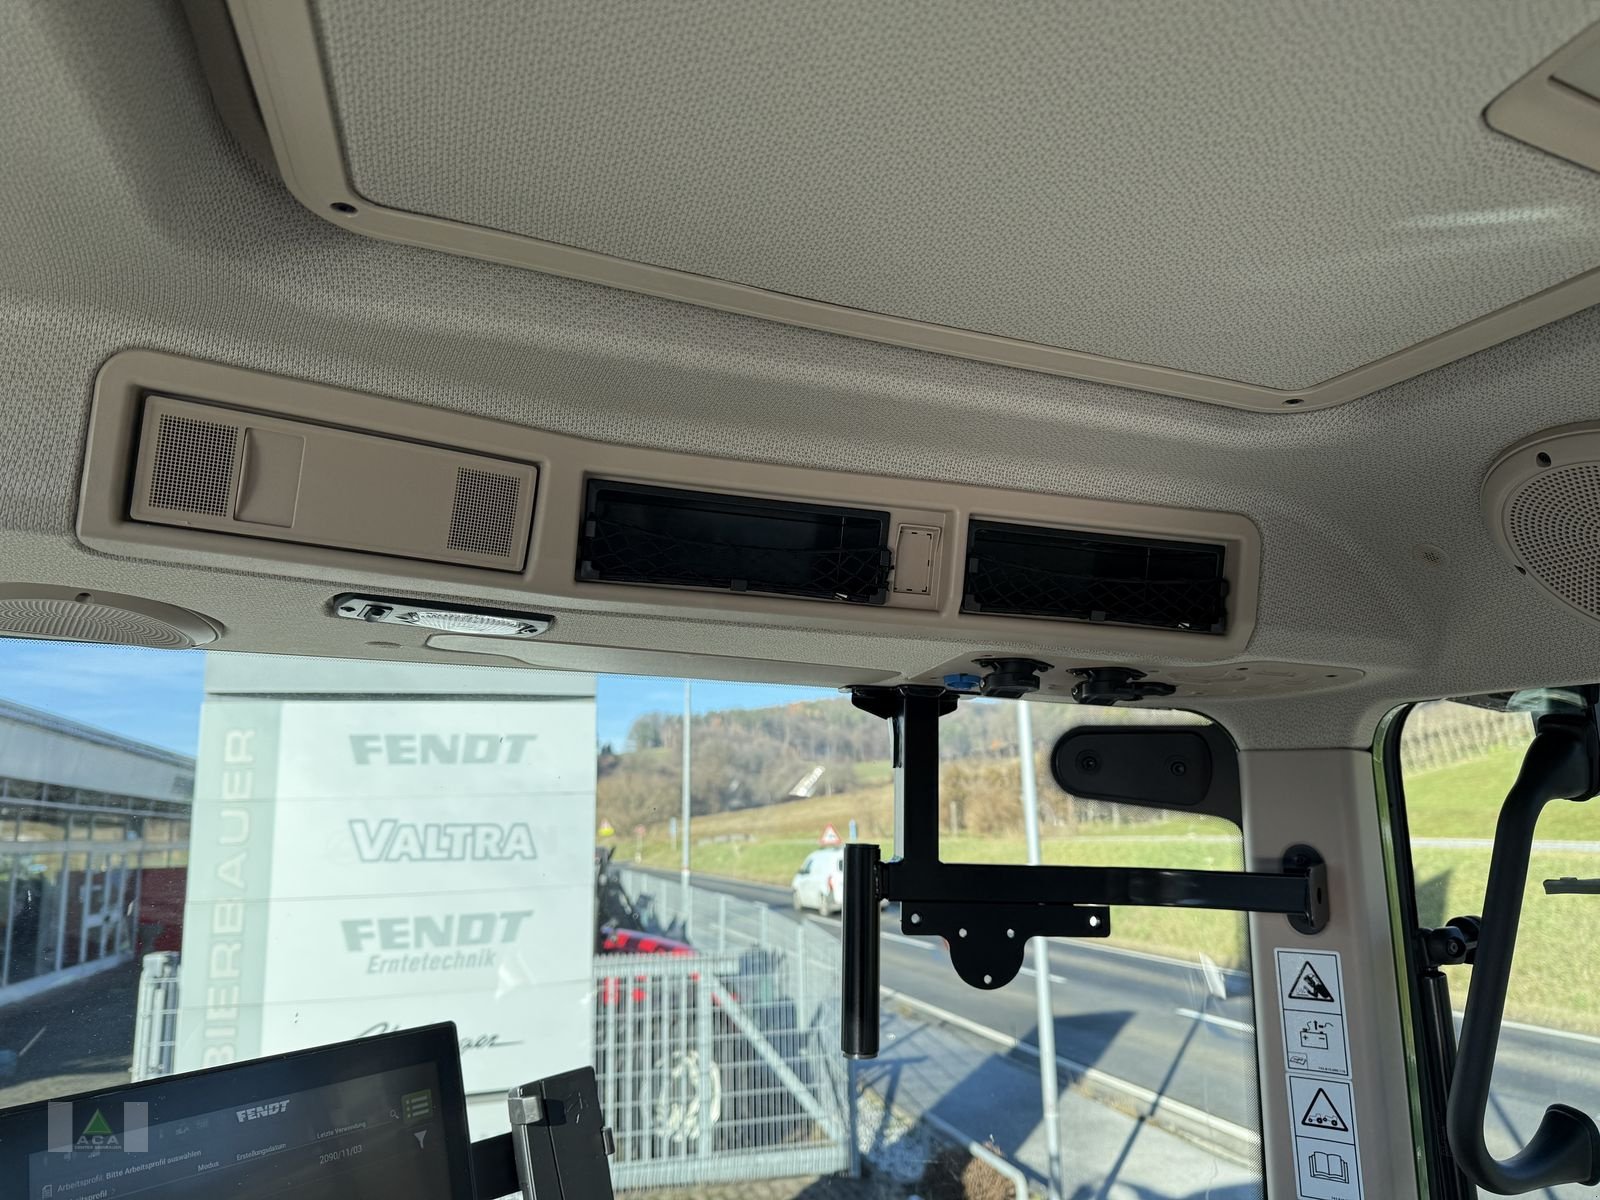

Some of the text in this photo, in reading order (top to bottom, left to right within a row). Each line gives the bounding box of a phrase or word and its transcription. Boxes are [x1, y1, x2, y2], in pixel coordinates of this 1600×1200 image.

[348, 733, 538, 765] FENDT
[348, 819, 538, 862] VALTRA
[203, 728, 256, 1067] BIERBAUER
[341, 910, 534, 952] FENDT
[366, 948, 496, 975] Erntetechnik
[236, 1099, 290, 1123] FENDT
[197, 1160, 220, 1172] Modus
[319, 1144, 363, 1165] 2090/11/03
[105, 1169, 123, 1181] Bitte
[124, 1158, 167, 1176] Arbeitsprofil
